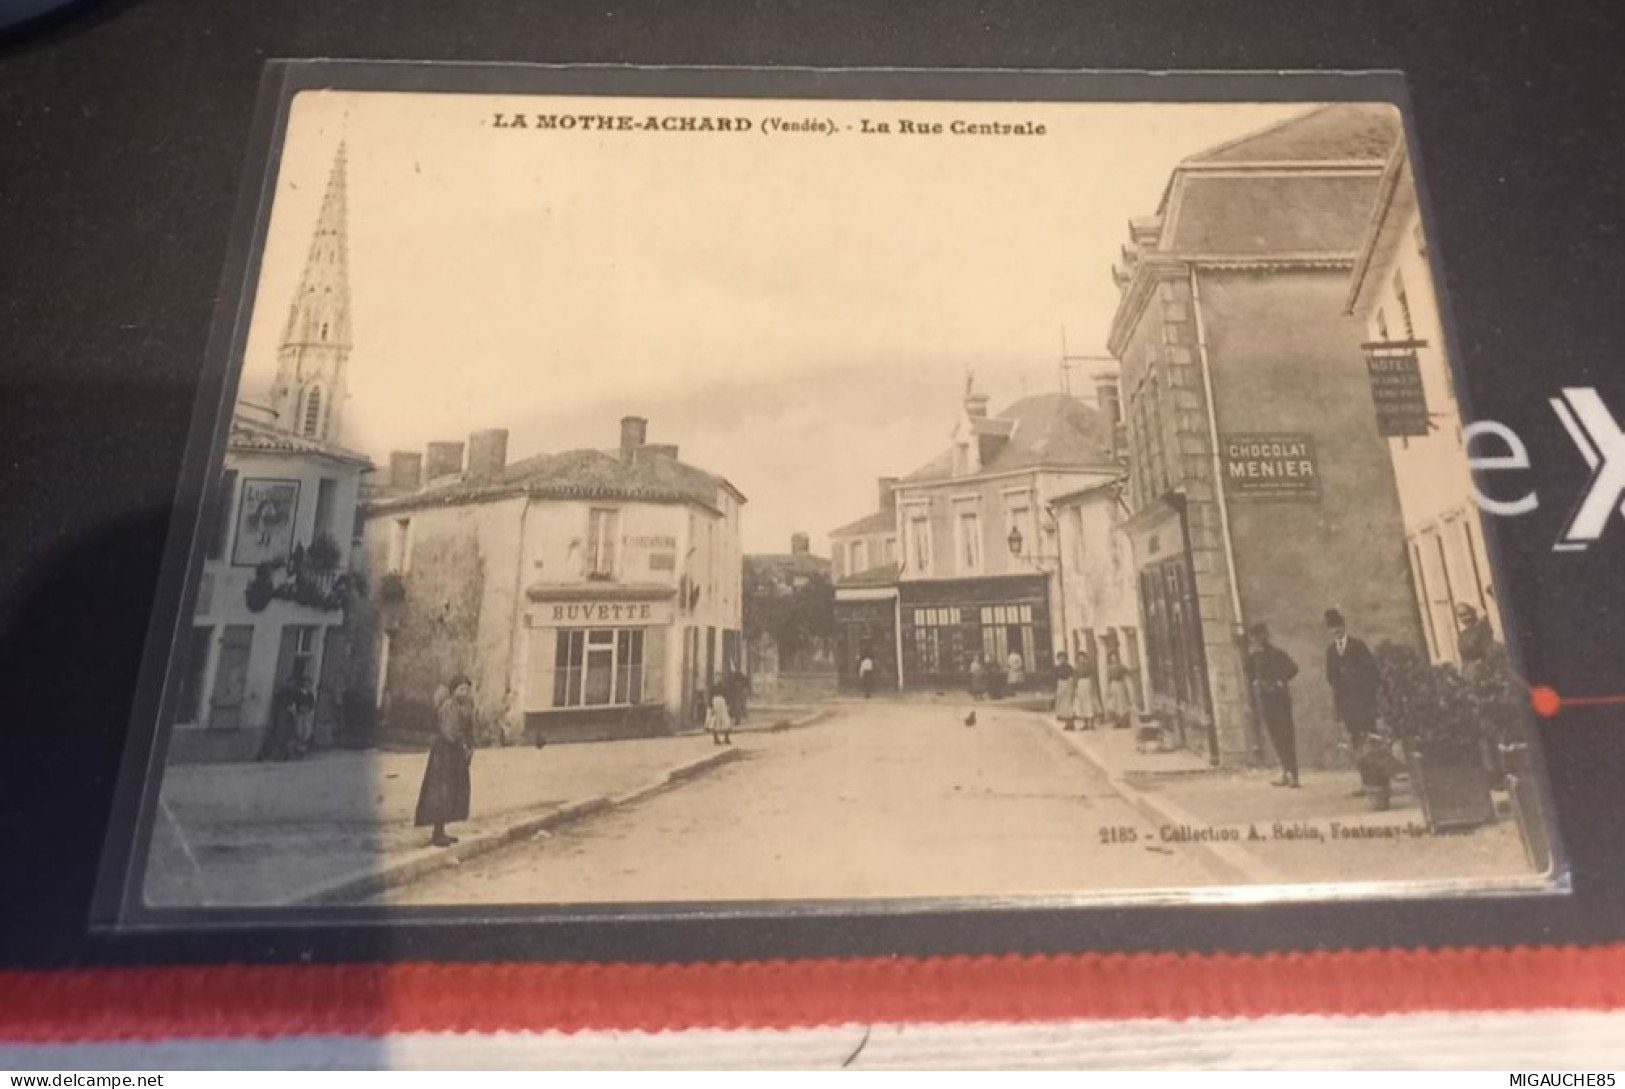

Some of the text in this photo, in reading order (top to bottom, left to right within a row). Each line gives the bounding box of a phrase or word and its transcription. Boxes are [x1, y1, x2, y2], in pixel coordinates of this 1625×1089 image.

[493, 113, 527, 129] LA
[535, 114, 752, 132] MOTHE-ACHARD
[760, 116, 839, 136] (Vendée).
[860, 118, 891, 134] La
[898, 119, 943, 134] Rue
[950, 119, 1047, 136] Centrale
[1229, 444, 1306, 457] CHOCOLAT
[1229, 461, 1313, 478] MENIER
[552, 603, 652, 621] BUVETTE
[1098, 825, 1137, 844] 2185
[1159, 824, 1240, 843] Collection
[1247, 822, 1266, 842] A.
